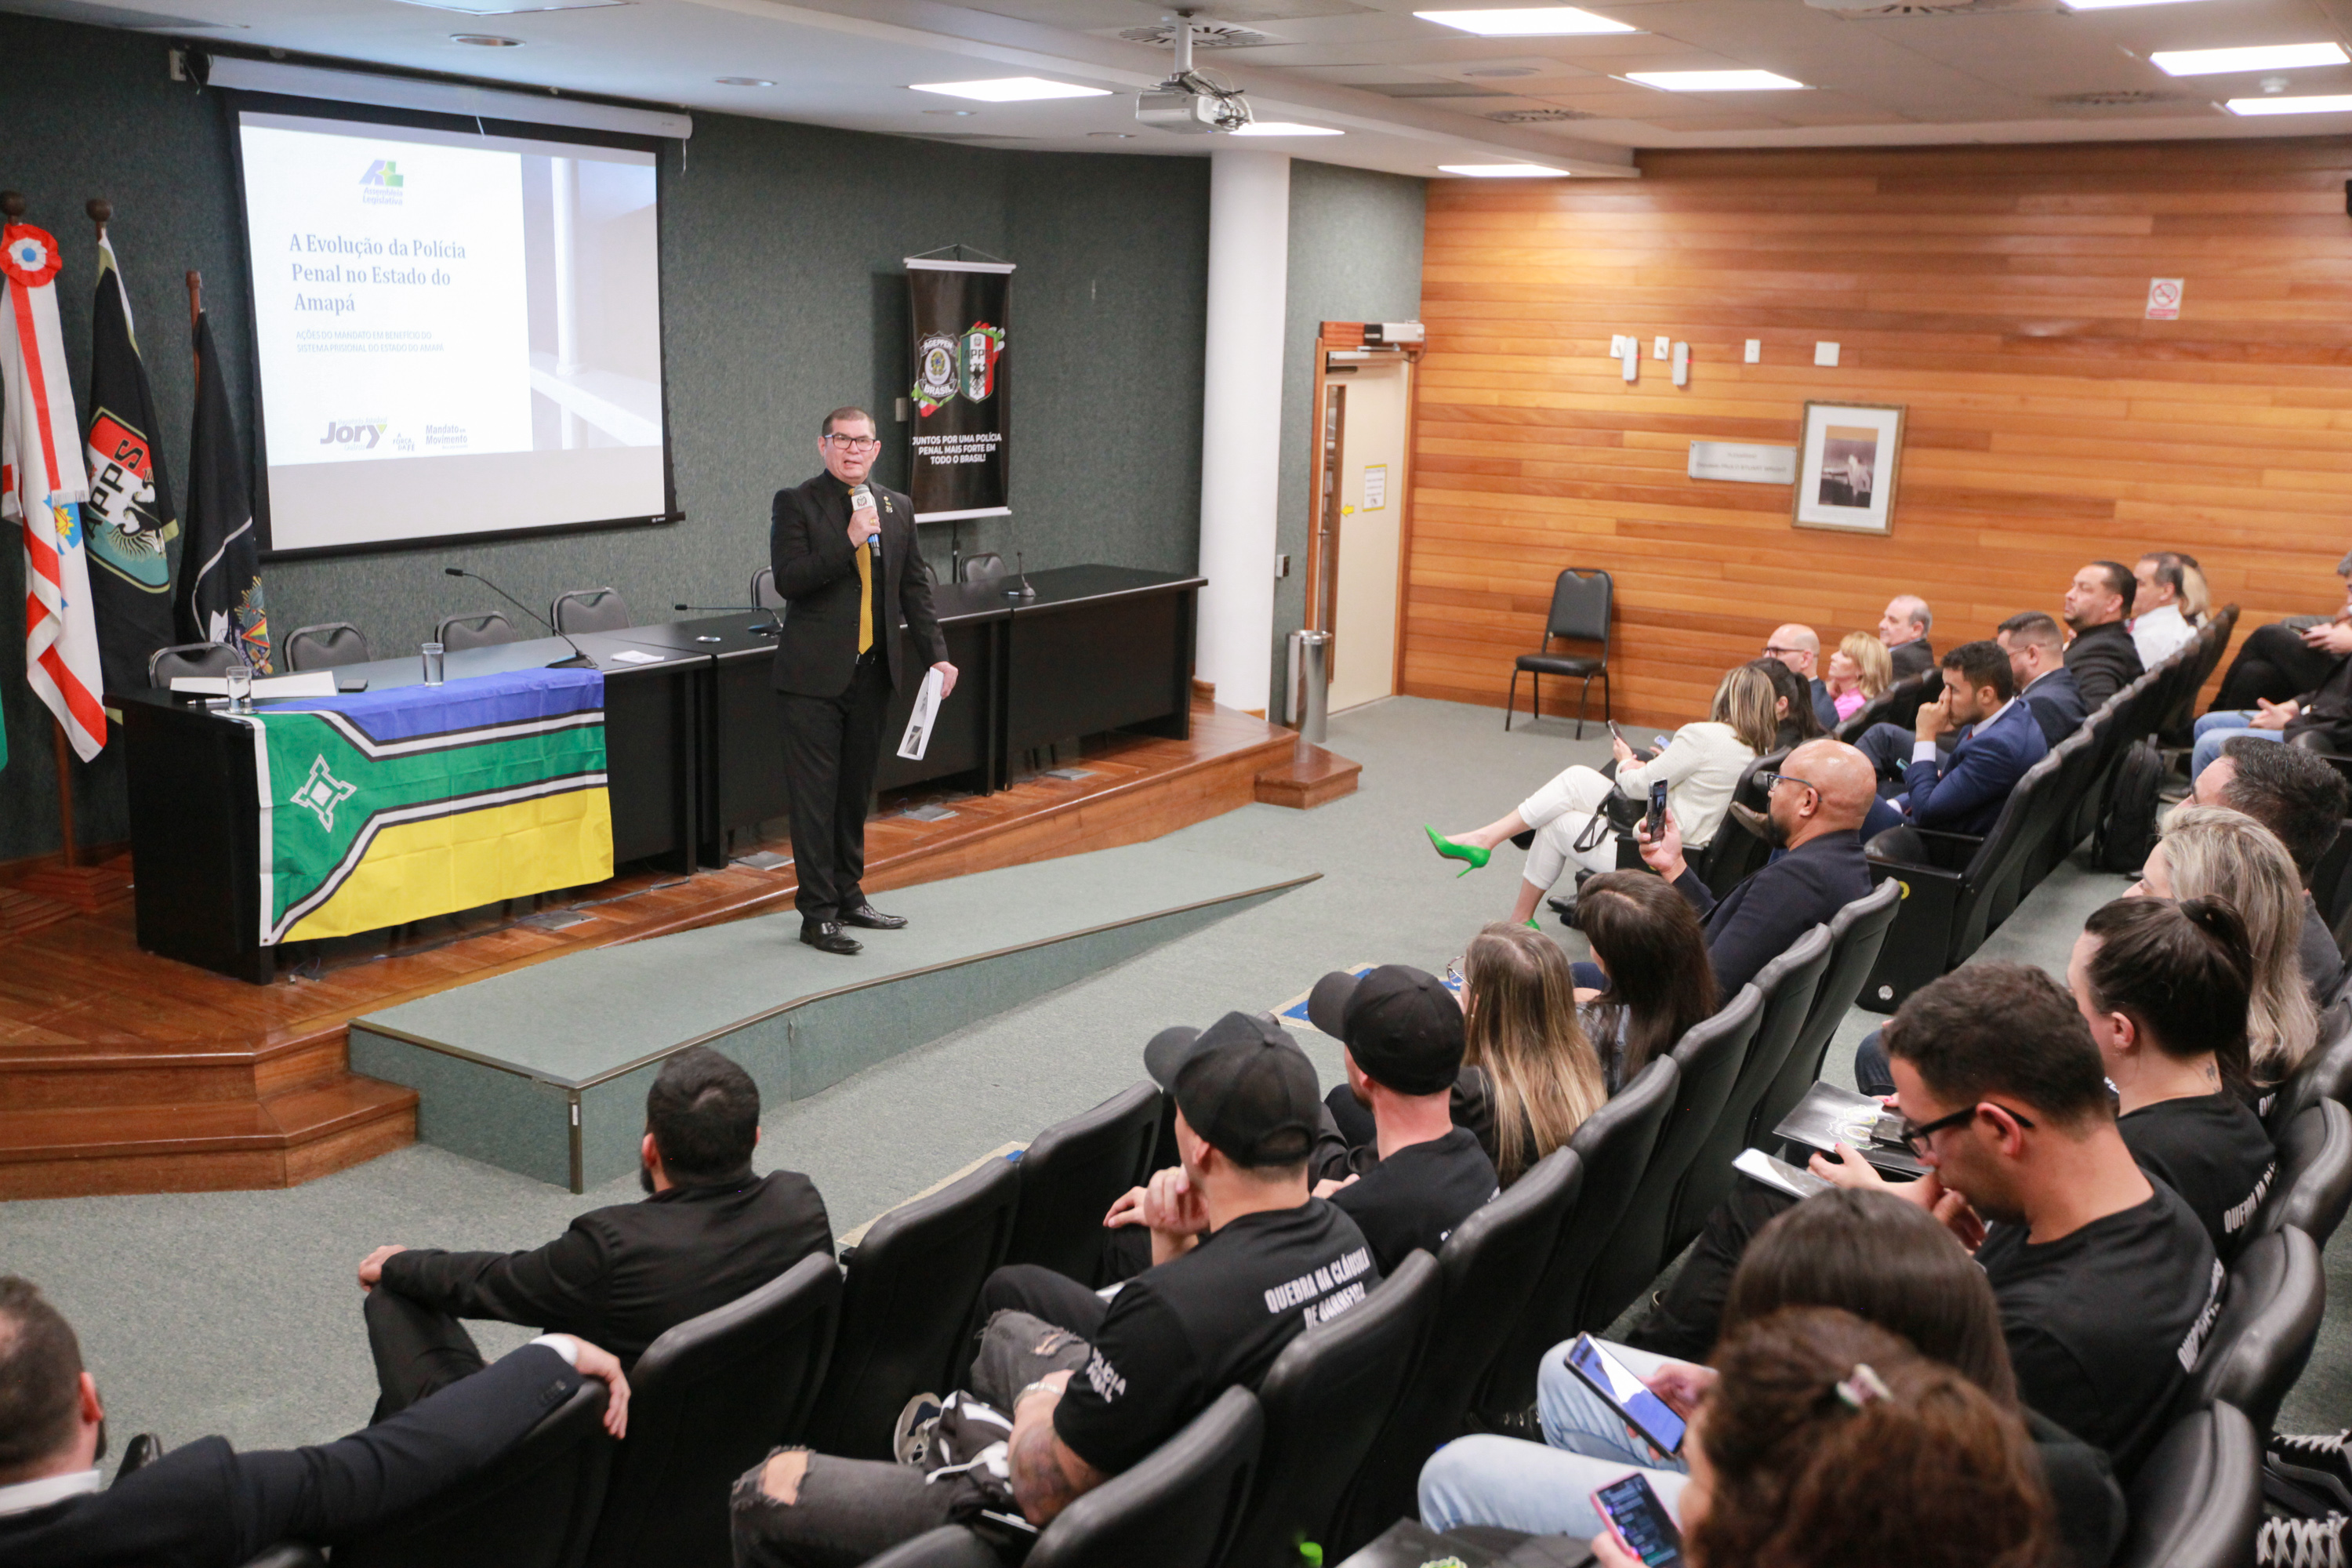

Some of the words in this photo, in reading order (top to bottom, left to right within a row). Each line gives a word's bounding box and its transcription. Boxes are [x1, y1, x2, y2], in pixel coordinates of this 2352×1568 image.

[363, 195, 403, 205] Legislativa
[289, 233, 302, 252] A
[306, 234, 383, 259] Evolução
[389, 238, 408, 256] da
[413, 239, 466, 259] Polícia
[292, 263, 341, 282] Penal
[347, 268, 367, 284] no
[372, 266, 426, 285] Estado
[431, 268, 451, 285] do
[294, 292, 355, 317] Amapá
[296, 329, 321, 342] AÇÕES
[321, 331, 332, 339] DO
[334, 330, 372, 339] MANDATO
[373, 331, 384, 339] EM
[385, 329, 420, 339] BENEFÍCIO
[421, 331, 432, 339] DO
[297, 343, 329, 353] SISTEMA
[330, 343, 367, 352] PRISIONAL
[368, 343, 379, 352] DO
[380, 343, 407, 352] ESTADO
[408, 343, 418, 352] DO
[419, 343, 445, 352] AMAPÁ
[964, 349, 992, 360] APPS
[923, 383, 953, 396] BRASIL
[320, 421, 387, 449] Jory
[426, 423, 459, 434] Mandato
[426, 434, 468, 445] Movimento
[912, 435, 941, 445] JUNTOS
[942, 435, 958, 445] POR
[959, 434, 975, 444] UMA
[975, 431, 1002, 443] POLÍCIA
[918, 445, 943, 456] PENAL
[944, 445, 963, 454] MAIS
[963, 444, 985, 453] FORTE
[985, 443, 996, 452] EM
[930, 455, 952, 465] TODO
[953, 455, 959, 464] O
[960, 454, 986, 463] BRASIL!
[82, 439, 143, 540] APPS
[1264, 1273, 1319, 1314] QUEBRA
[1314, 1266, 1334, 1293] NA
[1330, 1246, 1370, 1285] CLÁUSULA
[1303, 1304, 1319, 1330] DE
